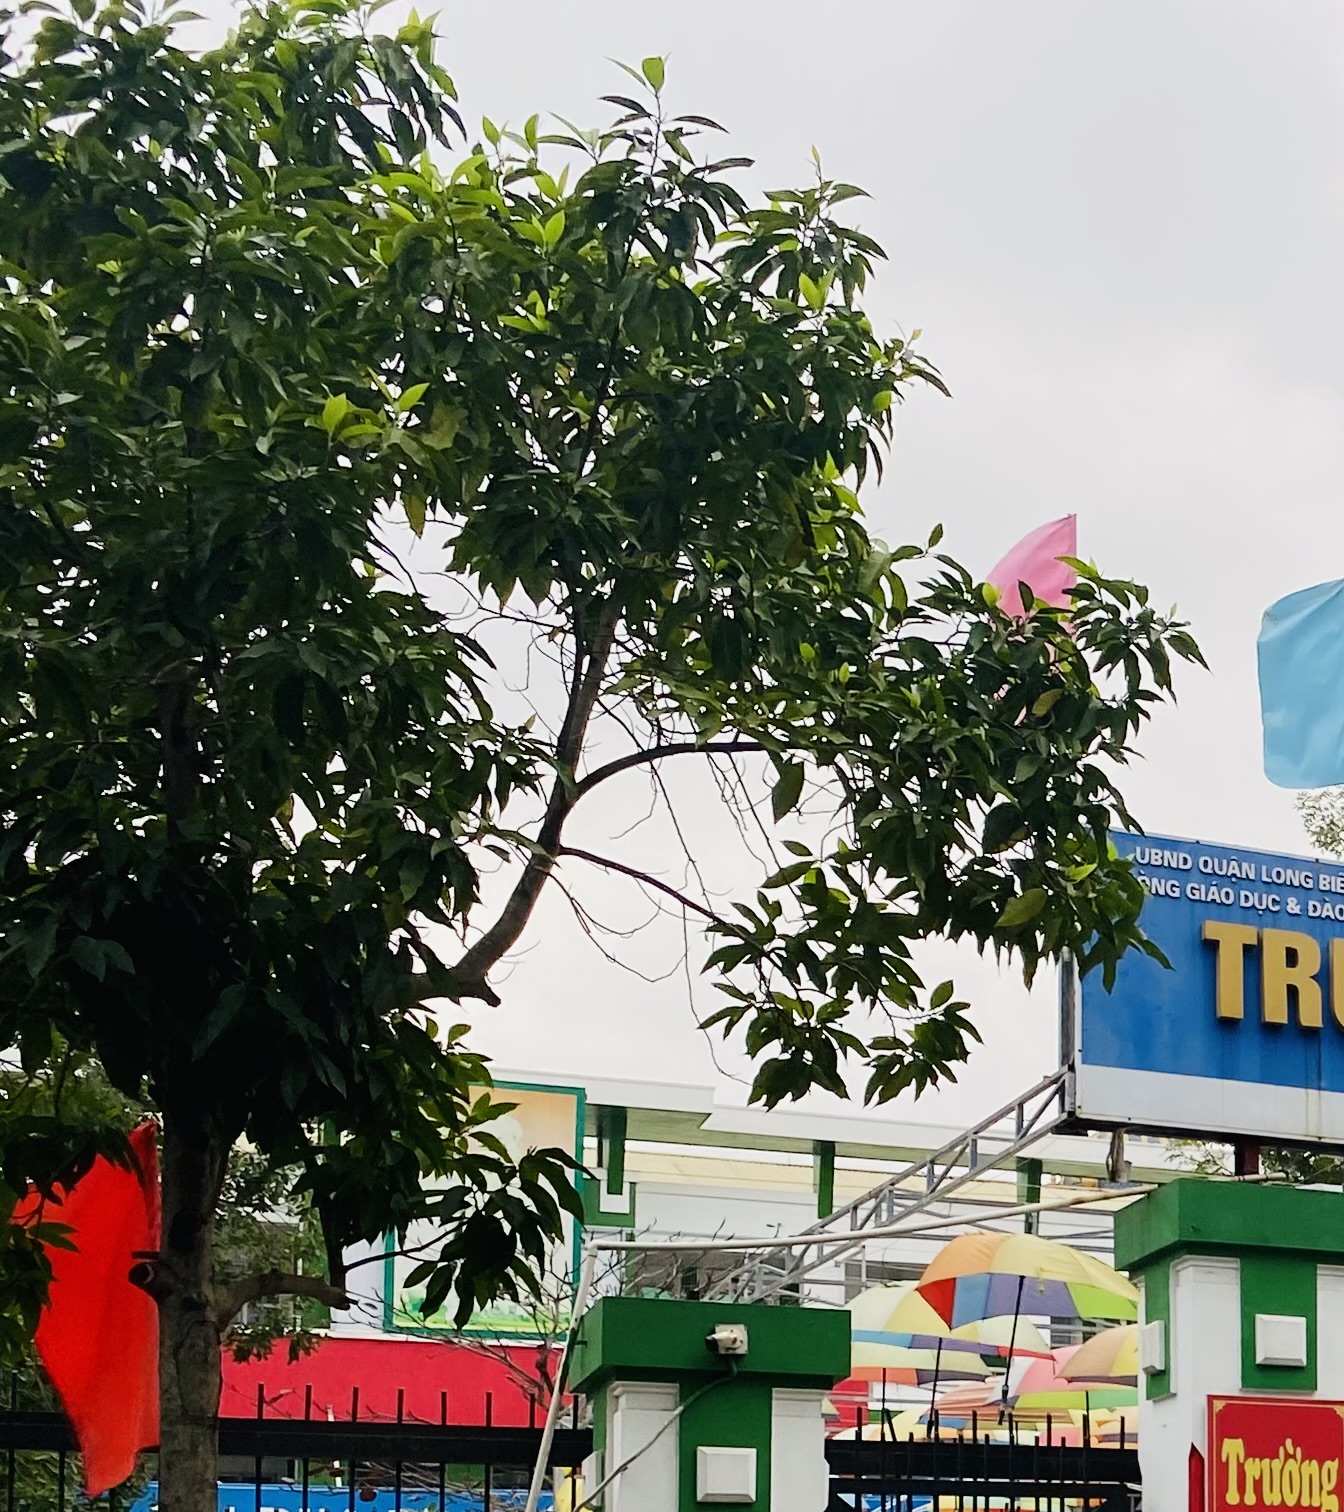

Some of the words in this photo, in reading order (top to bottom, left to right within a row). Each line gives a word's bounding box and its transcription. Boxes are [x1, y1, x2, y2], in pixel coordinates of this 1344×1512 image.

[1135, 846, 1193, 870] UBND
[1200, 856, 1256, 883] QUẬN
[1261, 865, 1314, 889] LONG
[1137, 873, 1181, 898] ÒNG
[1185, 881, 1235, 905] GIÁO
[1239, 893, 1281, 915] DỤC
[1286, 898, 1301, 915] &
